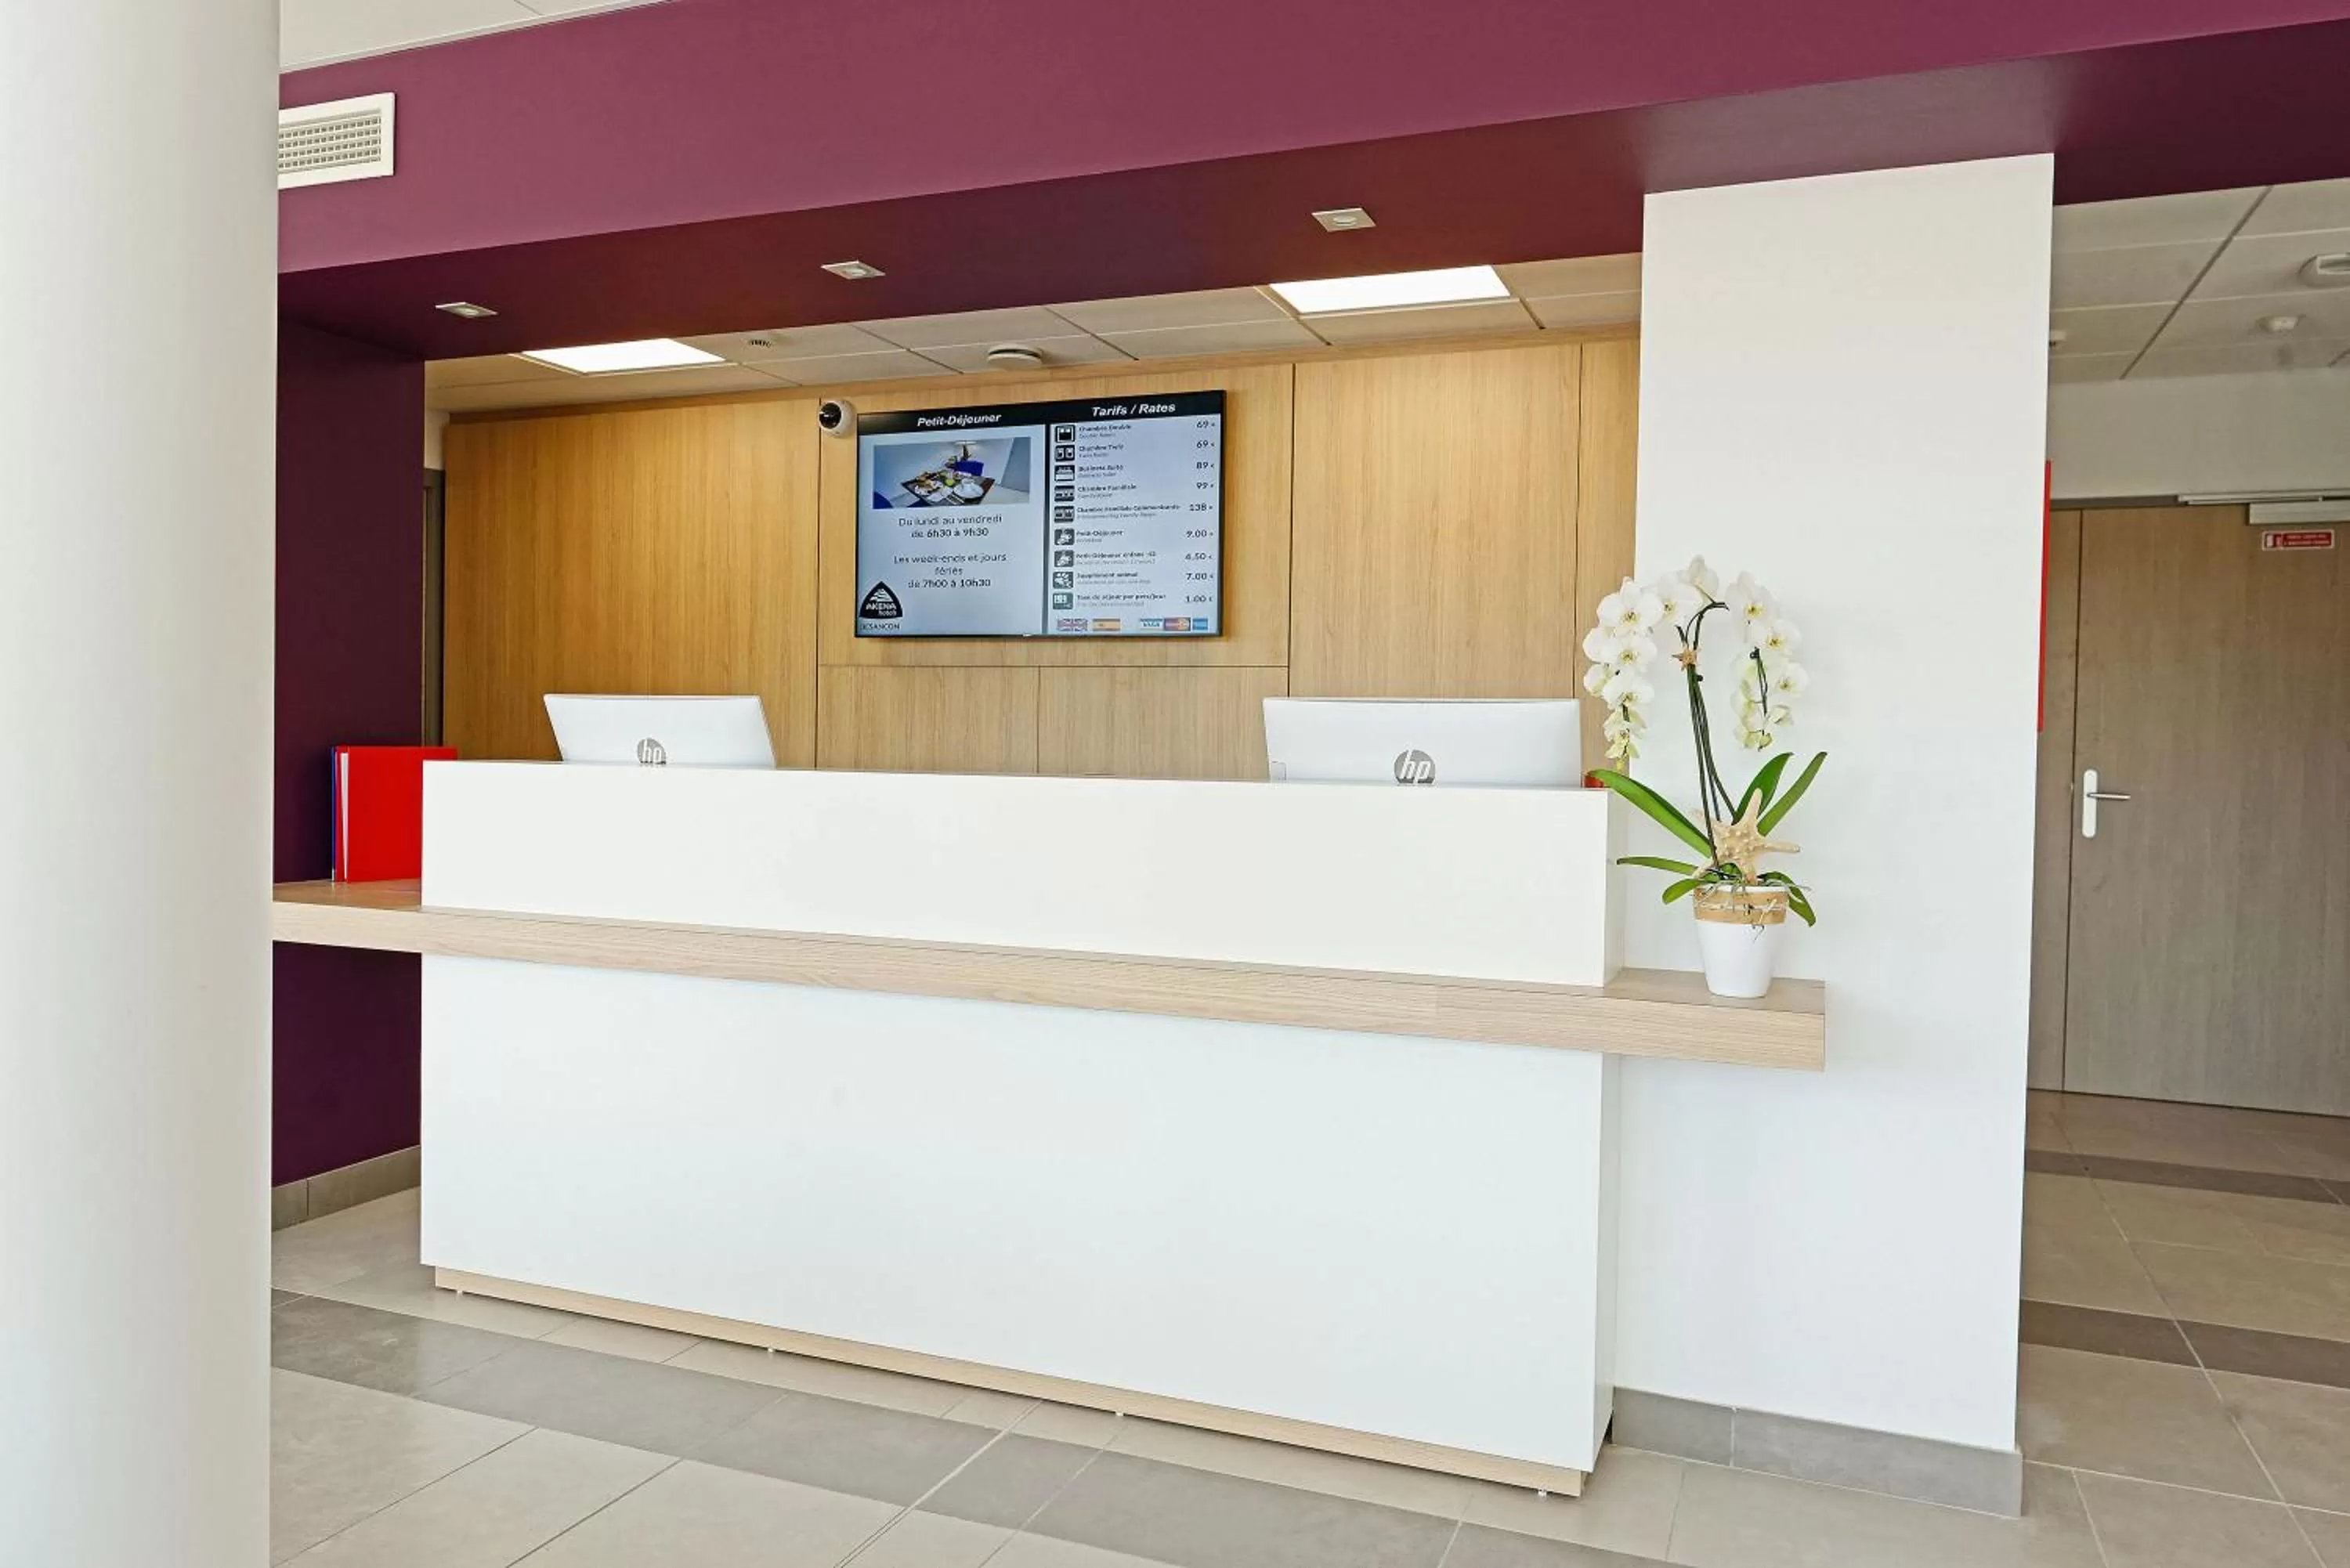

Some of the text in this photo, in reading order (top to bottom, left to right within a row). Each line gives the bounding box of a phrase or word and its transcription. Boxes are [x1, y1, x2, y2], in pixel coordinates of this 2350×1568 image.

[1092, 403, 1177, 417] Tarifs / Rates
[916, 414, 1003, 427] Petit-Déjeuner
[1196, 439, 1209, 449] 69
[1189, 503, 1207, 511] 138
[898, 513, 1003, 527] Du lundi au vendredi
[911, 526, 990, 538] de 6h30 à 9h30
[1186, 529, 1208, 539] 9.00
[893, 551, 1007, 565] Les week-ends et jours
[934, 565, 964, 576] fériés
[1185, 573, 1208, 581] 7.00
[907, 578, 992, 589] de 7h00 à 10h30
[1186, 594, 1207, 603] 1.00
[865, 602, 898, 610] AKENA
[1398, 749, 1433, 784] hp
